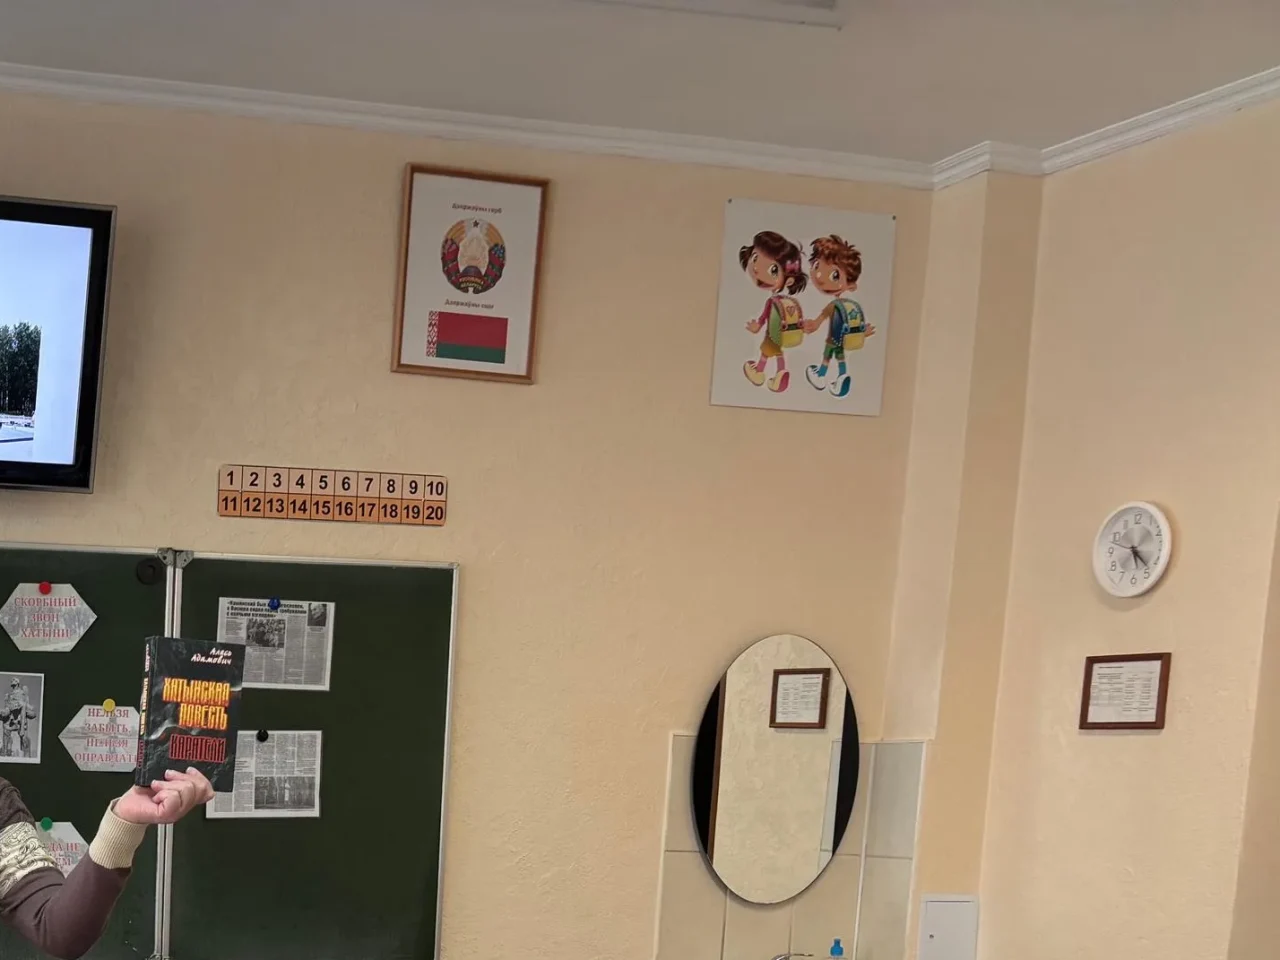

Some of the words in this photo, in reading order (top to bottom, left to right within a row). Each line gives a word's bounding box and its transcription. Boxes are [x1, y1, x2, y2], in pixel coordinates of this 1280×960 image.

[226, 470, 234, 486] 1
[249, 471, 259, 487] 2
[272, 472, 282, 488] 3
[295, 473, 306, 489] 4
[318, 474, 328, 490] 5
[341, 476, 351, 492] 6
[364, 477, 374, 492] 7
[386, 478, 396, 494] 8
[409, 479, 419, 495] 9
[426, 480, 445, 496] 10
[221, 495, 237, 512] 11
[243, 496, 262, 513] 12
[266, 497, 285, 514] 13
[289, 499, 308, 515] 14
[312, 500, 331, 516] 15
[335, 501, 354, 517] 16
[358, 502, 377, 517] 17
[381, 503, 399, 519] 18
[403, 504, 421, 520] 19
[425, 505, 444, 521] 20
[14, 596, 77, 607] СКОРБНЫЙ
[31, 613, 59, 622] ЗВОН
[191, 653, 231, 665] Адамович
[210, 647, 232, 656] Алесь
[163, 677, 231, 706] ХАТЫНСКАЯ
[87, 707, 129, 718] НЕЛЬЗЯ
[178, 702, 228, 730] ПОВЕСТЬ
[168, 733, 227, 764] КАРАТЕЛИ
